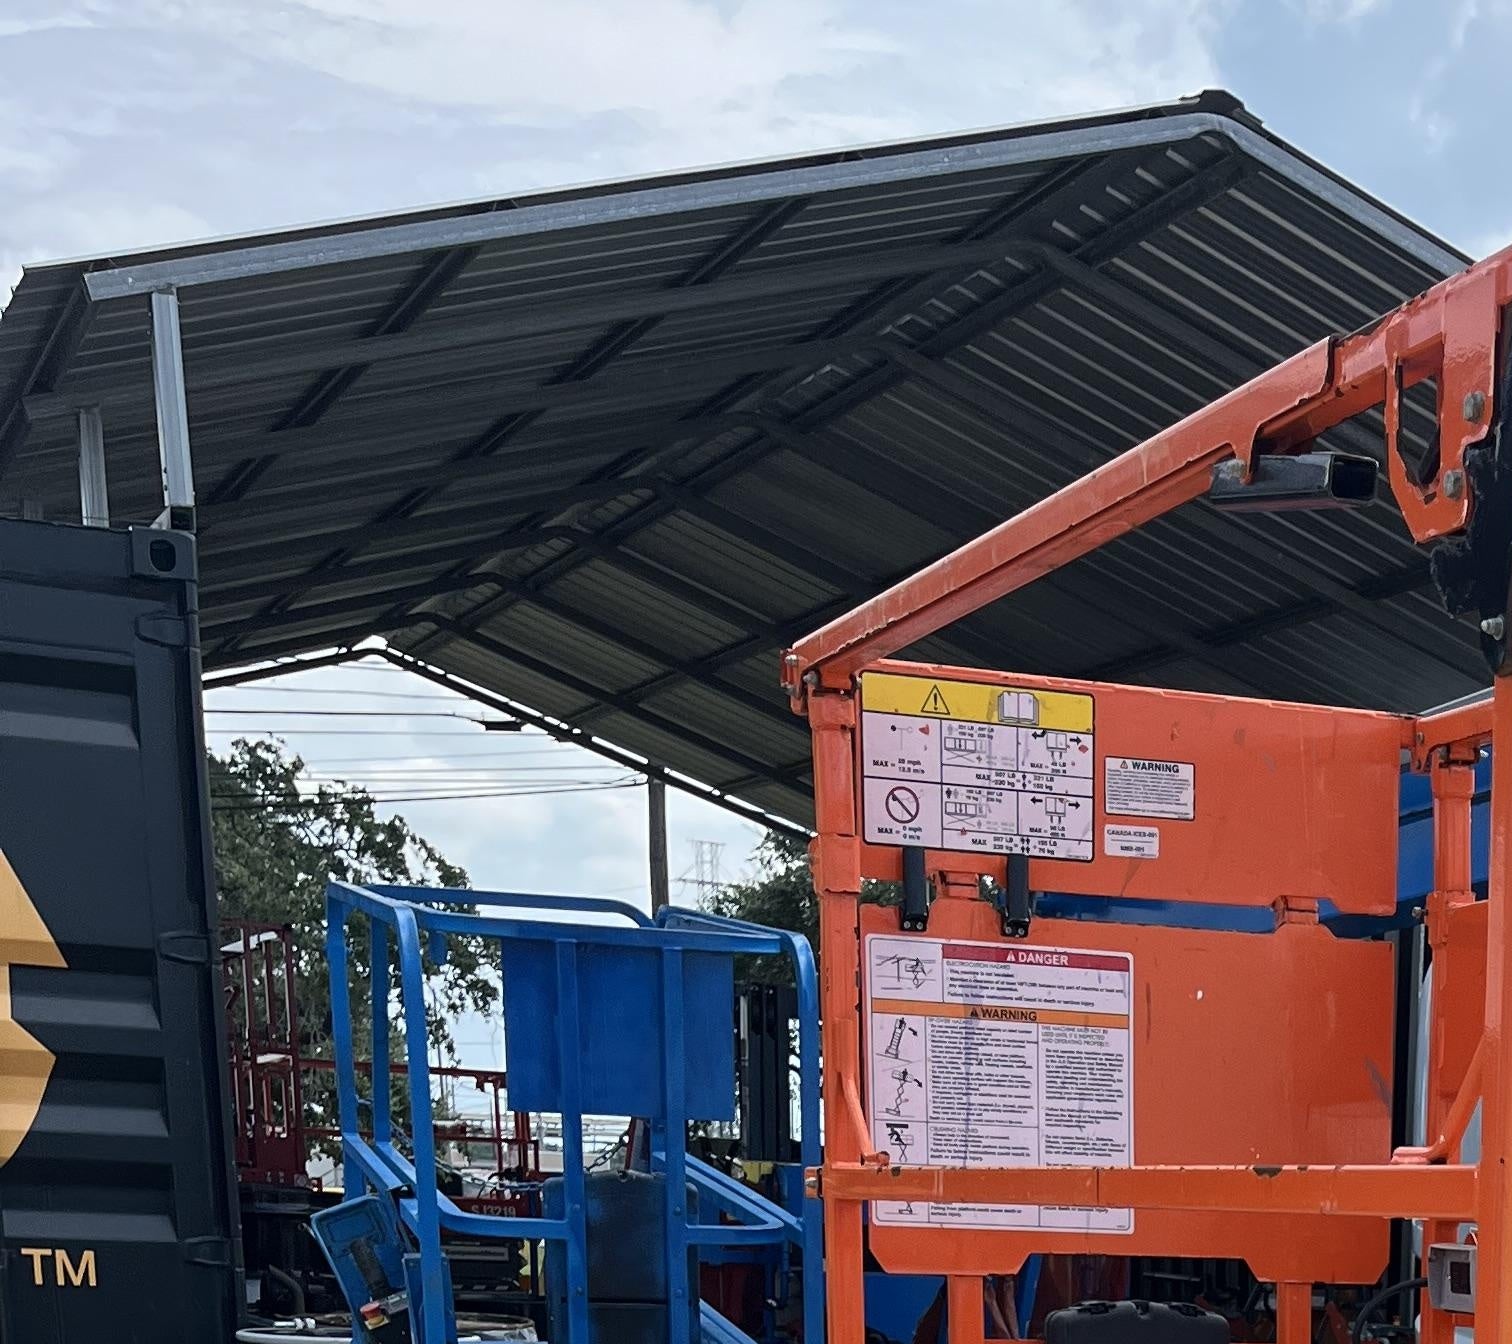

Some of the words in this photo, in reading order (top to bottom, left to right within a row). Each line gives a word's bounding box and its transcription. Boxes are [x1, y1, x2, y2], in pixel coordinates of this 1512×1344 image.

[1132, 761, 1179, 773] WARNING
[1018, 952, 1069, 966] DANGER
[981, 1008, 1037, 1021] WARNING
[20, 1248, 97, 1287] TM
